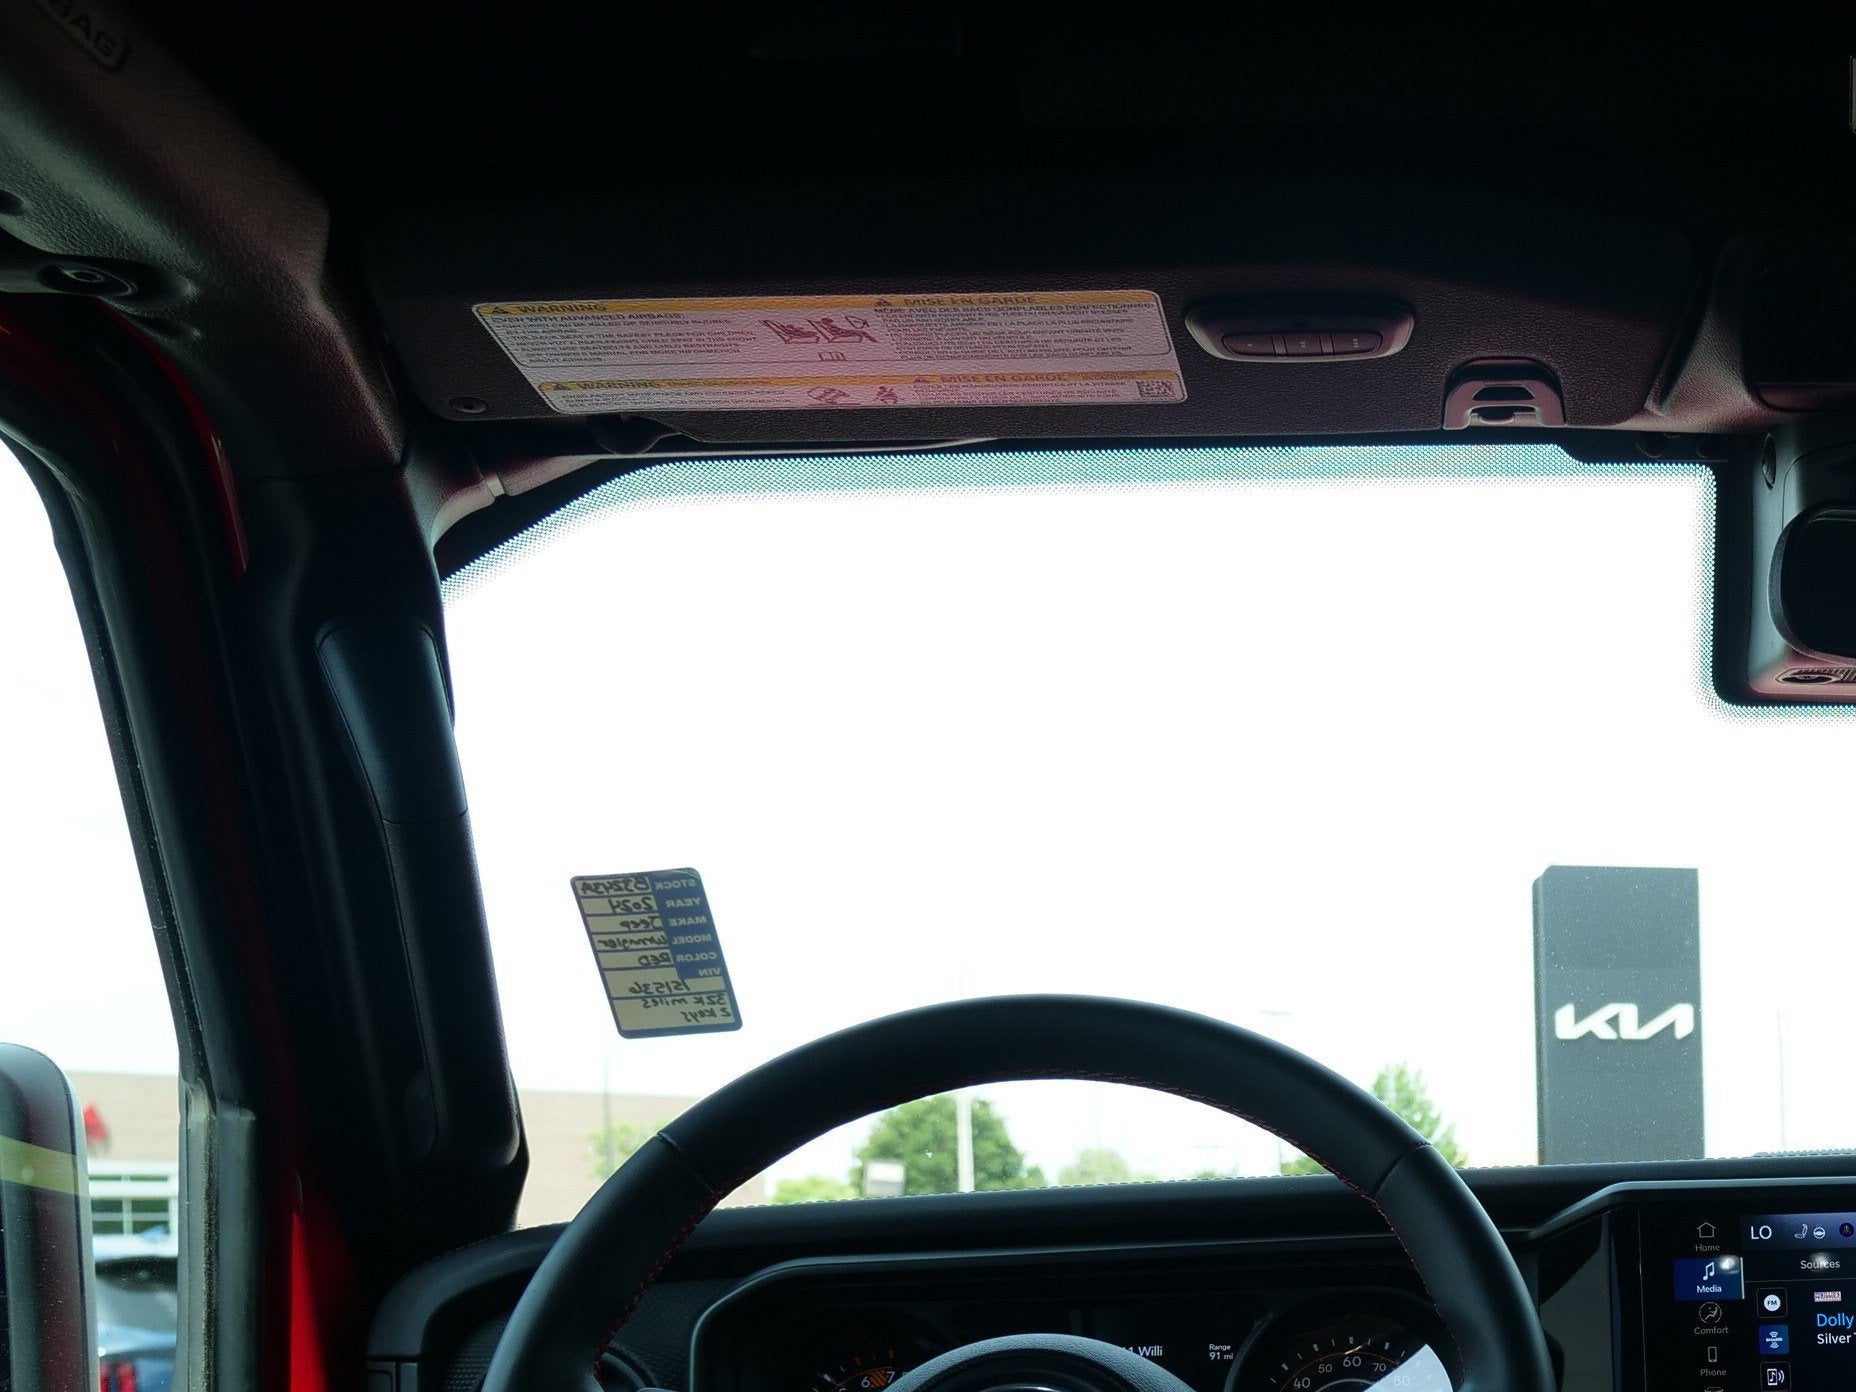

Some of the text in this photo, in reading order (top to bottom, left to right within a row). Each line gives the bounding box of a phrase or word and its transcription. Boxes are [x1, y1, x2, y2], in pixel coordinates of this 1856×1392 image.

[904, 298, 947, 306] MISE
[978, 296, 1037, 305] GARDE
[517, 304, 607, 314] WARNING
[1555, 1003, 1694, 1040] KIA
[1750, 1225, 1773, 1240] LO
[1695, 1243, 1721, 1252] Home
[1800, 1259, 1841, 1270] Sources
[1697, 1284, 1723, 1294] Media
[1816, 1313, 1854, 1329] Dolly
[1694, 1326, 1729, 1335] Comfort
[1816, 1332, 1852, 1345] Silver
[1208, 1343, 1231, 1352] Range
[1209, 1352, 1234, 1360] 91 mi
[1343, 1356, 1361, 1368] 60
[1373, 1362, 1386, 1372] 70
[1318, 1362, 1333, 1374] 50
[1700, 1368, 1727, 1377] Phone
[861, 1376, 871, 1388] 6
[886, 1371, 896, 1384] 7
[1293, 1378, 1311, 1389] 40
